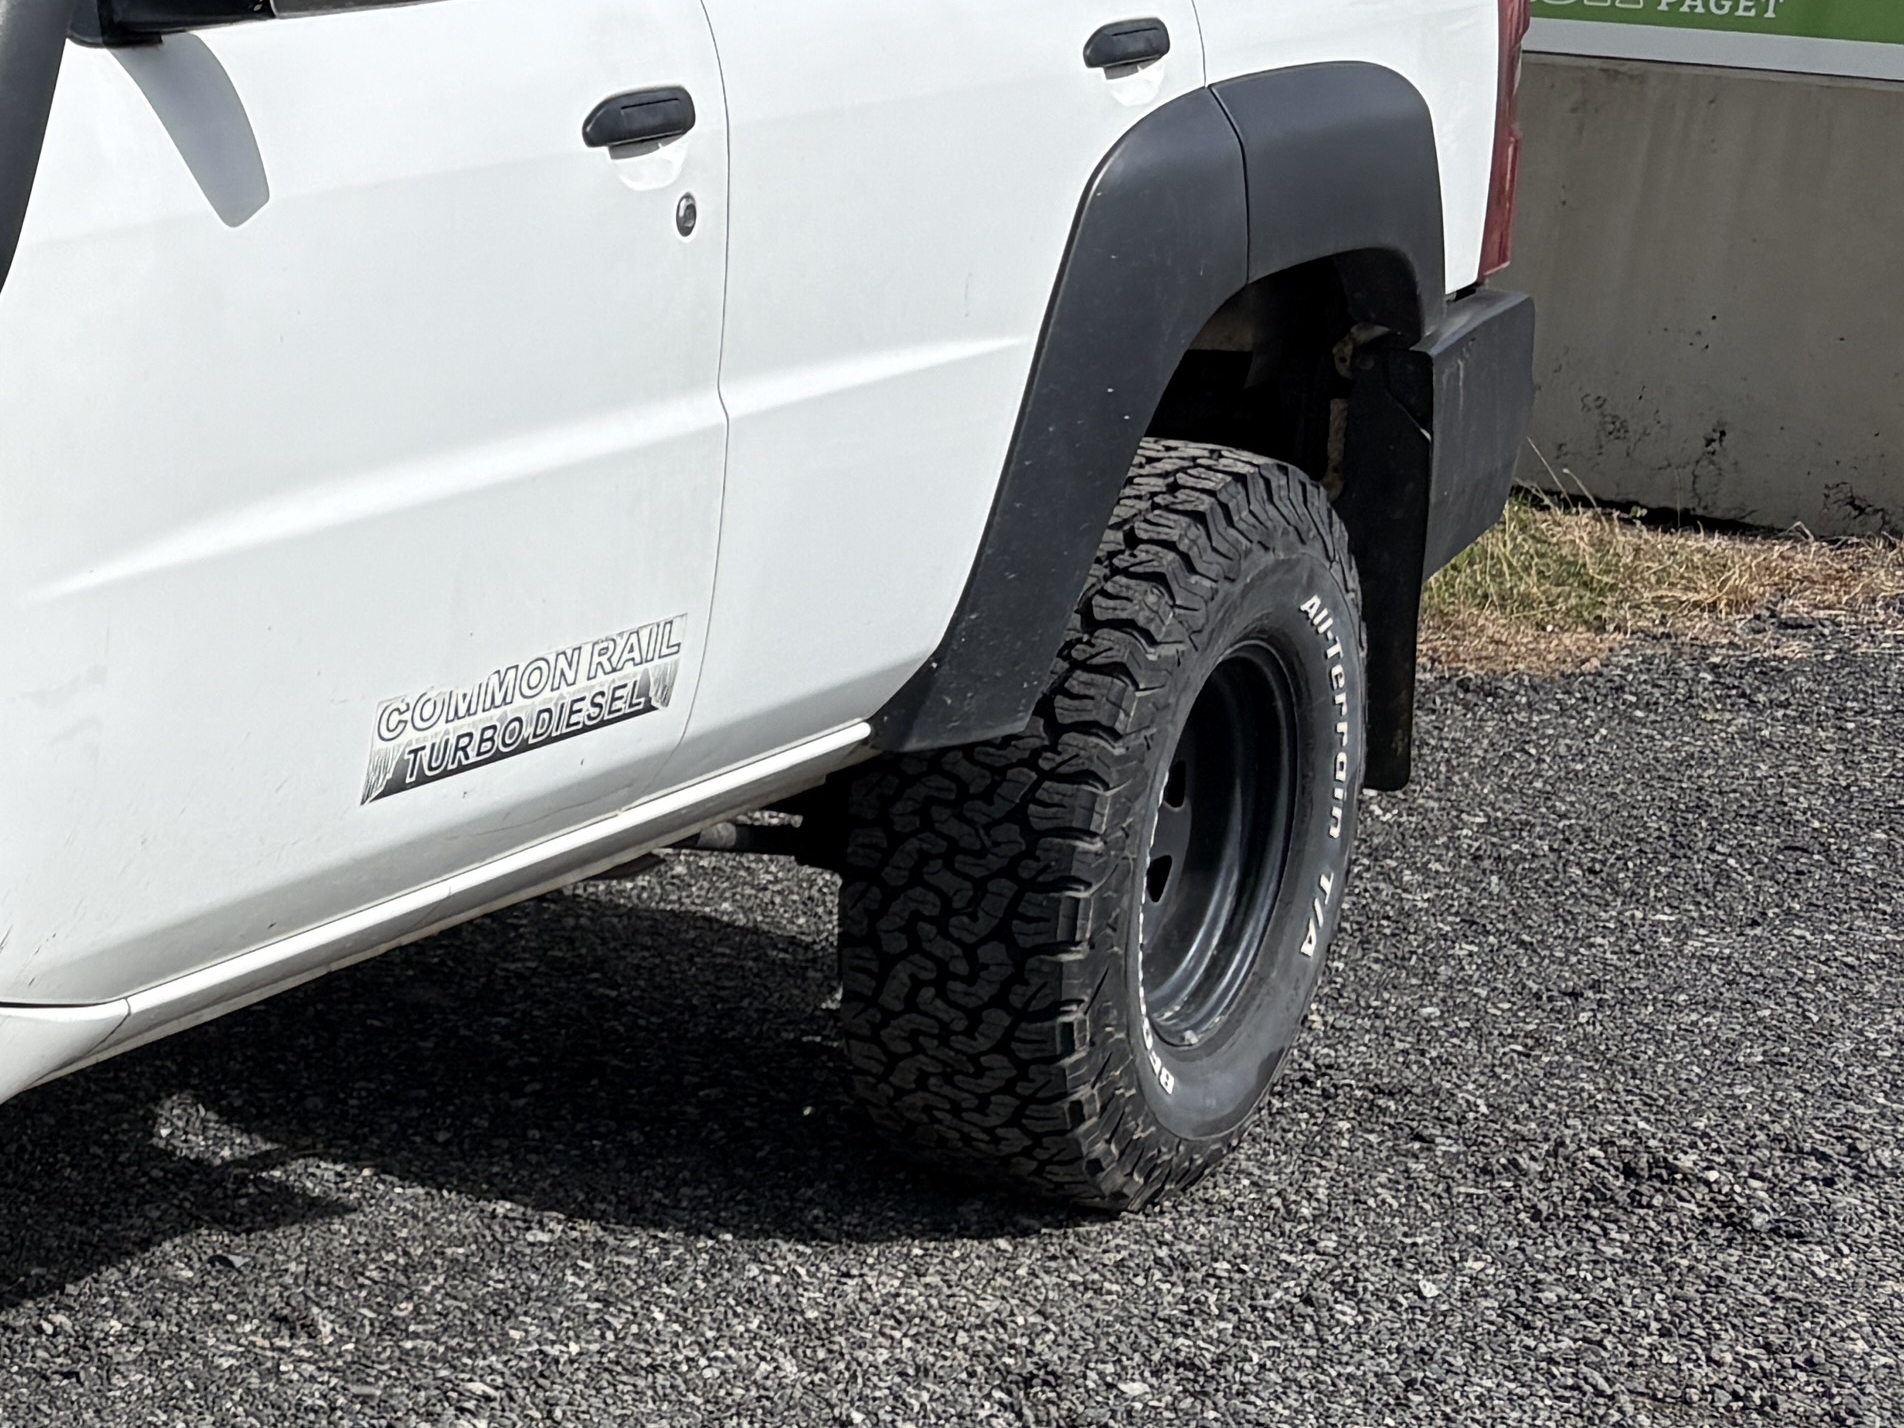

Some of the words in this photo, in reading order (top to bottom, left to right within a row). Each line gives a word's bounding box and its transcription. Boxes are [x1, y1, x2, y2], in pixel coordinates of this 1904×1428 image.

[376, 644, 583, 743] COMMON
[586, 618, 683, 682] RAIL
[403, 714, 526, 784] TURBO
[530, 676, 648, 749] DIESEL
